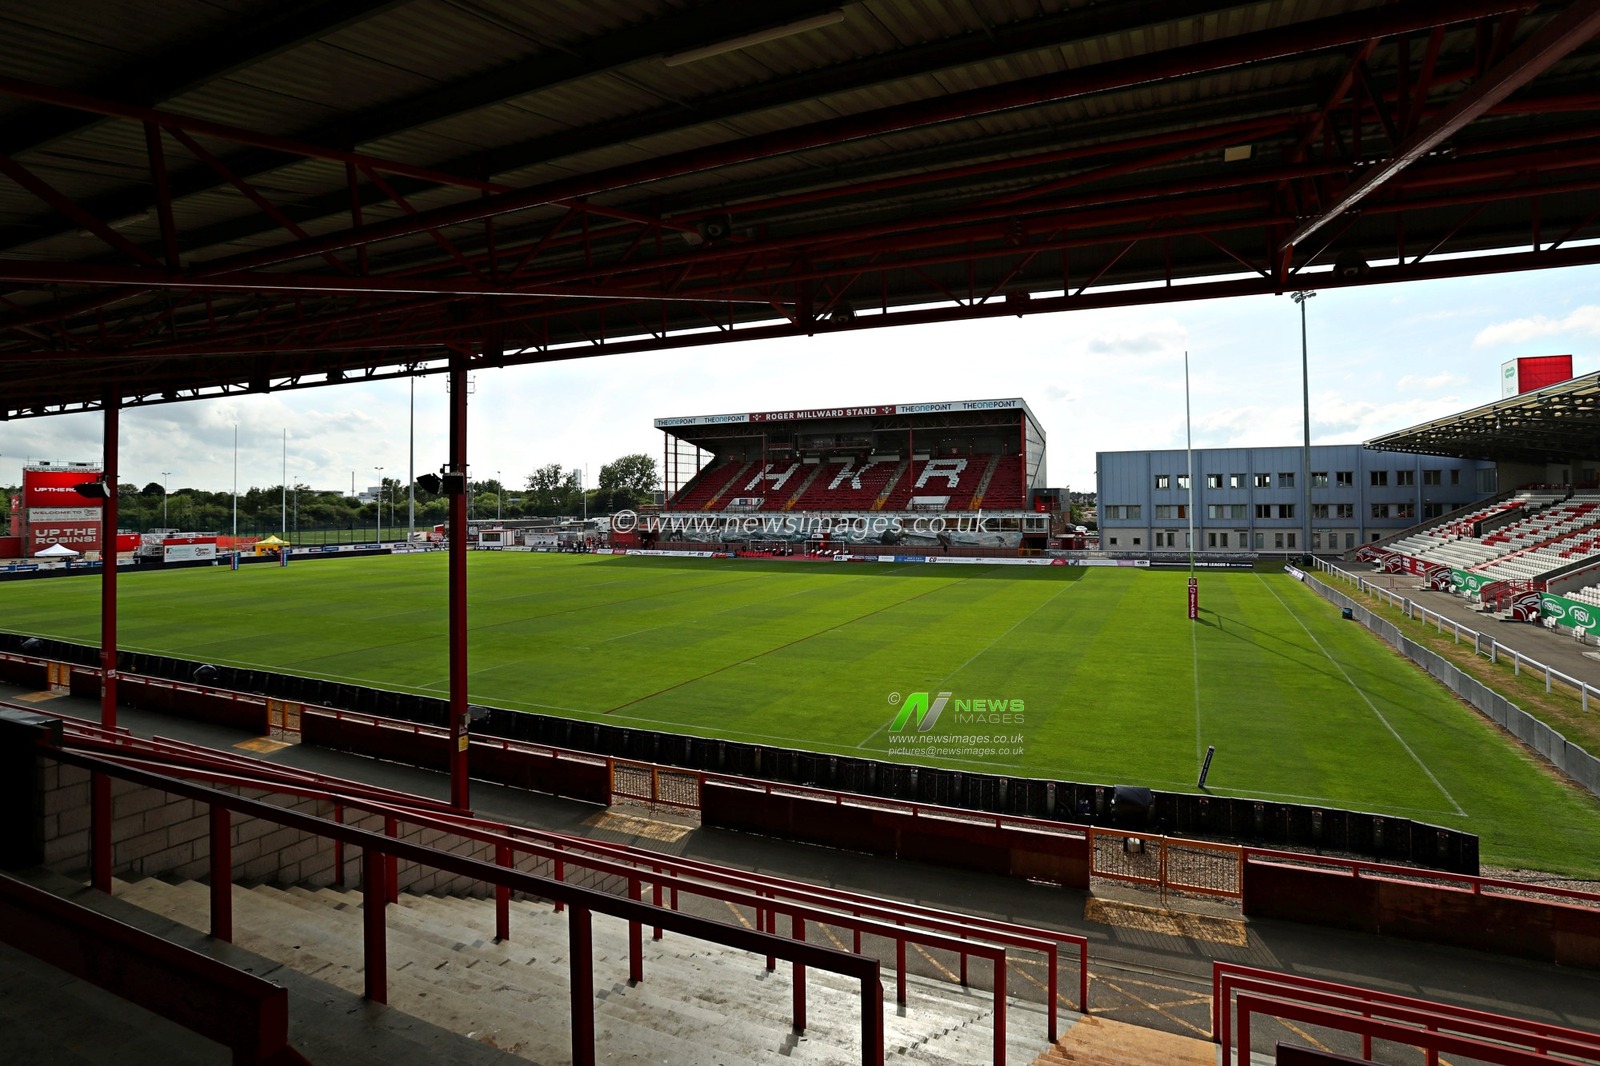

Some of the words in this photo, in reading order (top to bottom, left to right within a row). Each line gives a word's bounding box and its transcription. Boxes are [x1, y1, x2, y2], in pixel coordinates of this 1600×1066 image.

[765, 412, 794, 421] ROGER
[797, 409, 843, 419] MILLWARD
[846, 407, 877, 416] STAND
[35, 529, 61, 537] UP
[63, 528, 97, 536] THE
[35, 536, 96, 544] ROBINS!
[1574, 609, 1589, 623] RSV
